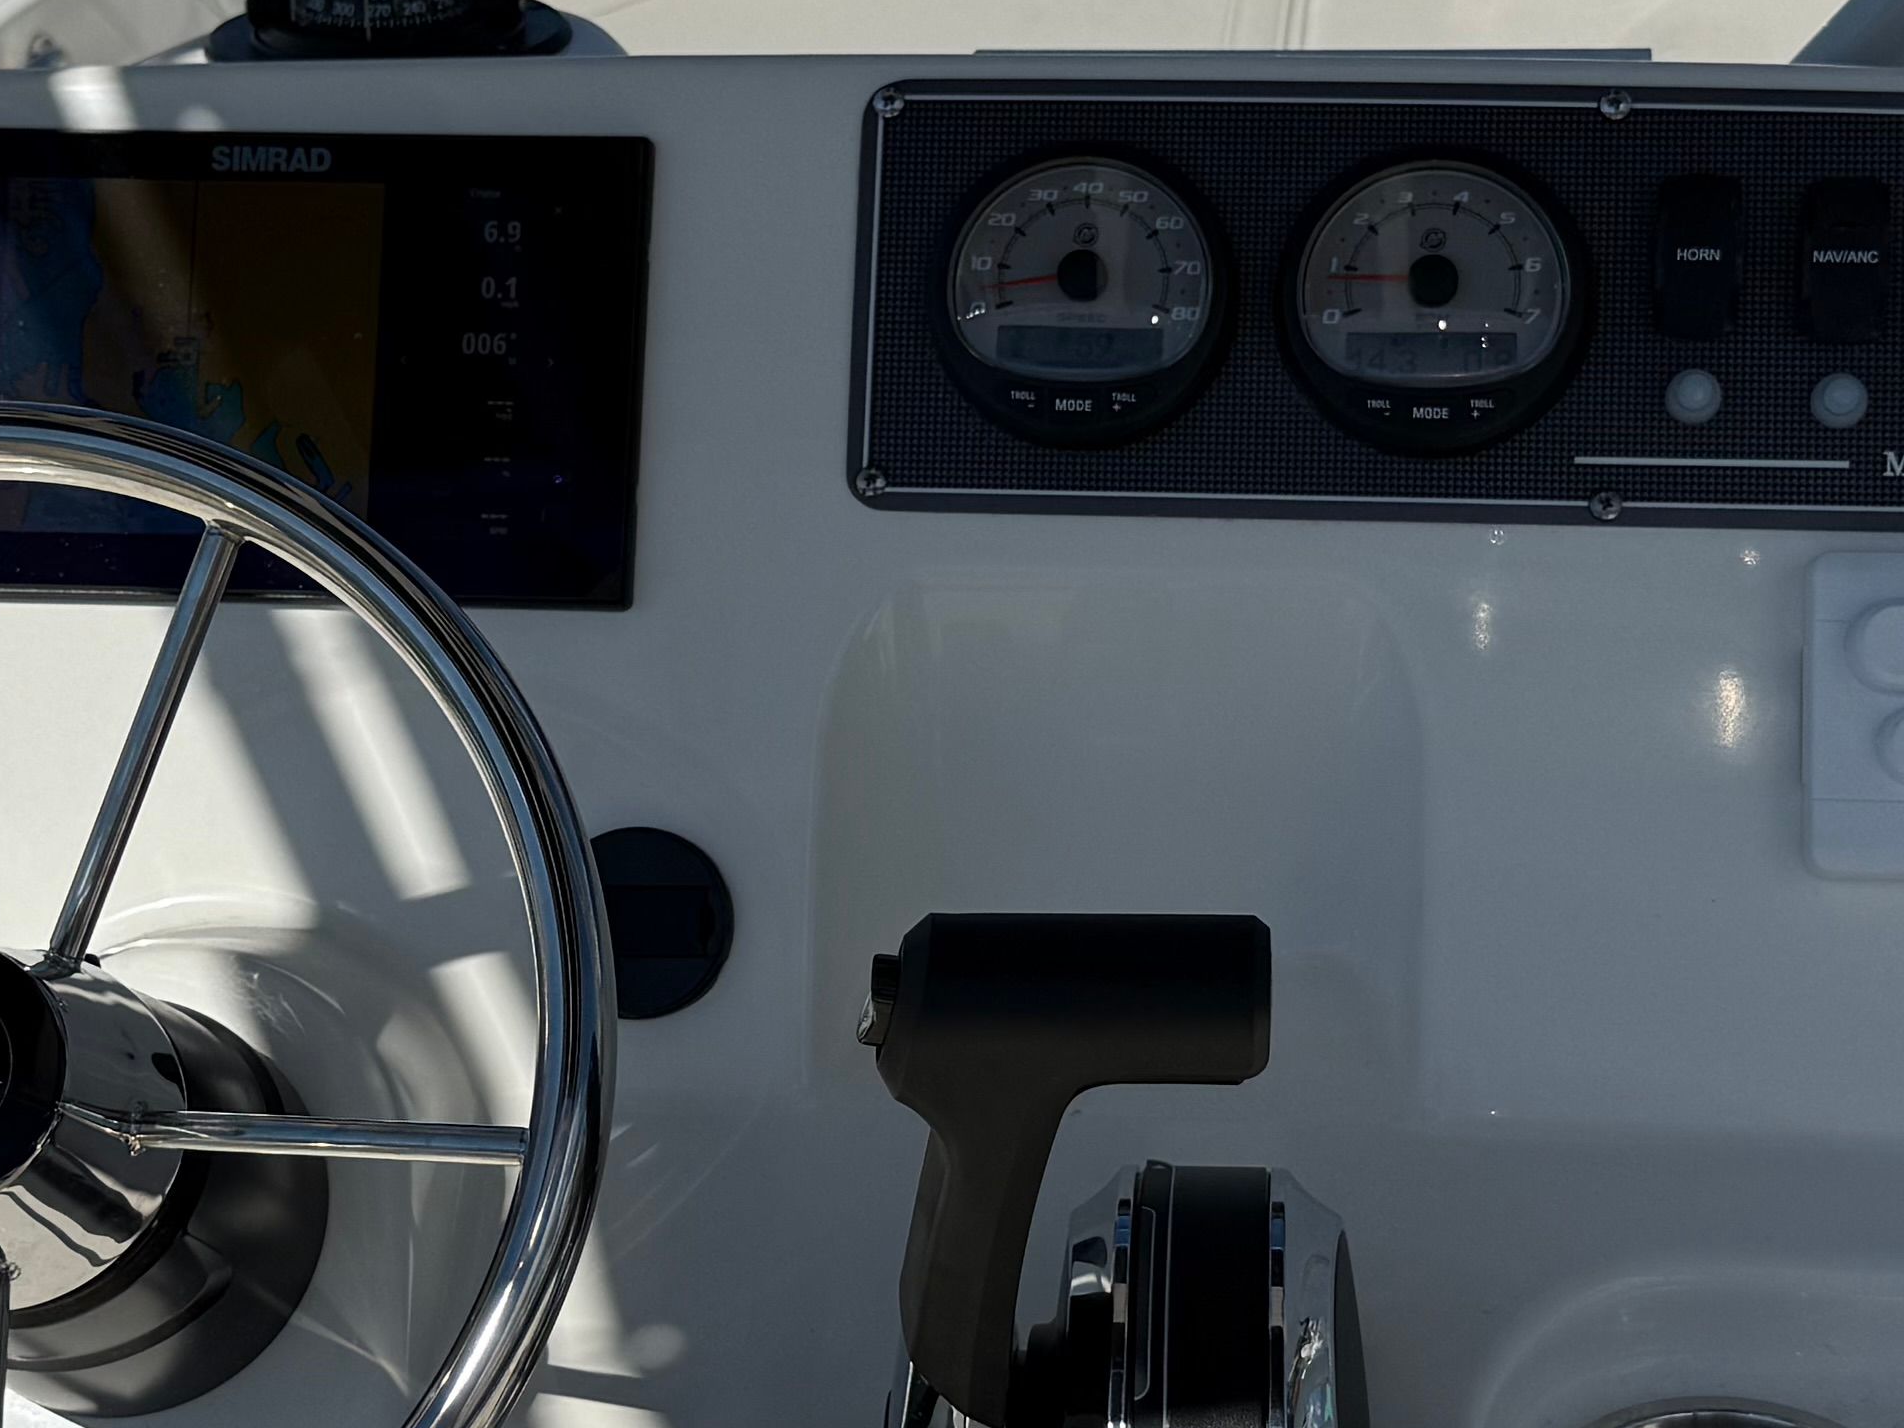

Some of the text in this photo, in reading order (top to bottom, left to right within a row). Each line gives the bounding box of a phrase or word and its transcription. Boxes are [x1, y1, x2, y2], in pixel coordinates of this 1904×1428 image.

[367, 3, 391, 17] 270
[211, 146, 332, 173] SIMRAD
[1072, 182, 1104, 194] 40
[1028, 189, 1058, 202] 30
[1118, 190, 1149, 203] 50
[1399, 191, 1413, 203] 3
[1453, 191, 1470, 203] 4
[987, 212, 1017, 227] 20
[1155, 216, 1184, 230] 60
[1352, 213, 1370, 225] 2
[1500, 212, 1516, 225] 5
[483, 219, 522, 244] 6.9
[1676, 247, 1720, 263] HORN
[1812, 248, 1879, 265] NAV/ANC
[971, 256, 992, 271] 10
[1172, 261, 1201, 276] 70
[1330, 257, 1338, 272] 1
[1525, 257, 1543, 272] 6
[480, 275, 518, 300] 0.1
[1171, 306, 1200, 321] 80
[1322, 308, 1340, 324] 0
[1524, 309, 1542, 324] 7
[1010, 390, 1036, 400] TROLL
[1112, 392, 1136, 403] TROLL
[1054, 399, 1093, 412] MODE
[1367, 399, 1391, 409] TROLL
[1470, 399, 1495, 409] TROLL
[1412, 407, 1449, 420] MODE
